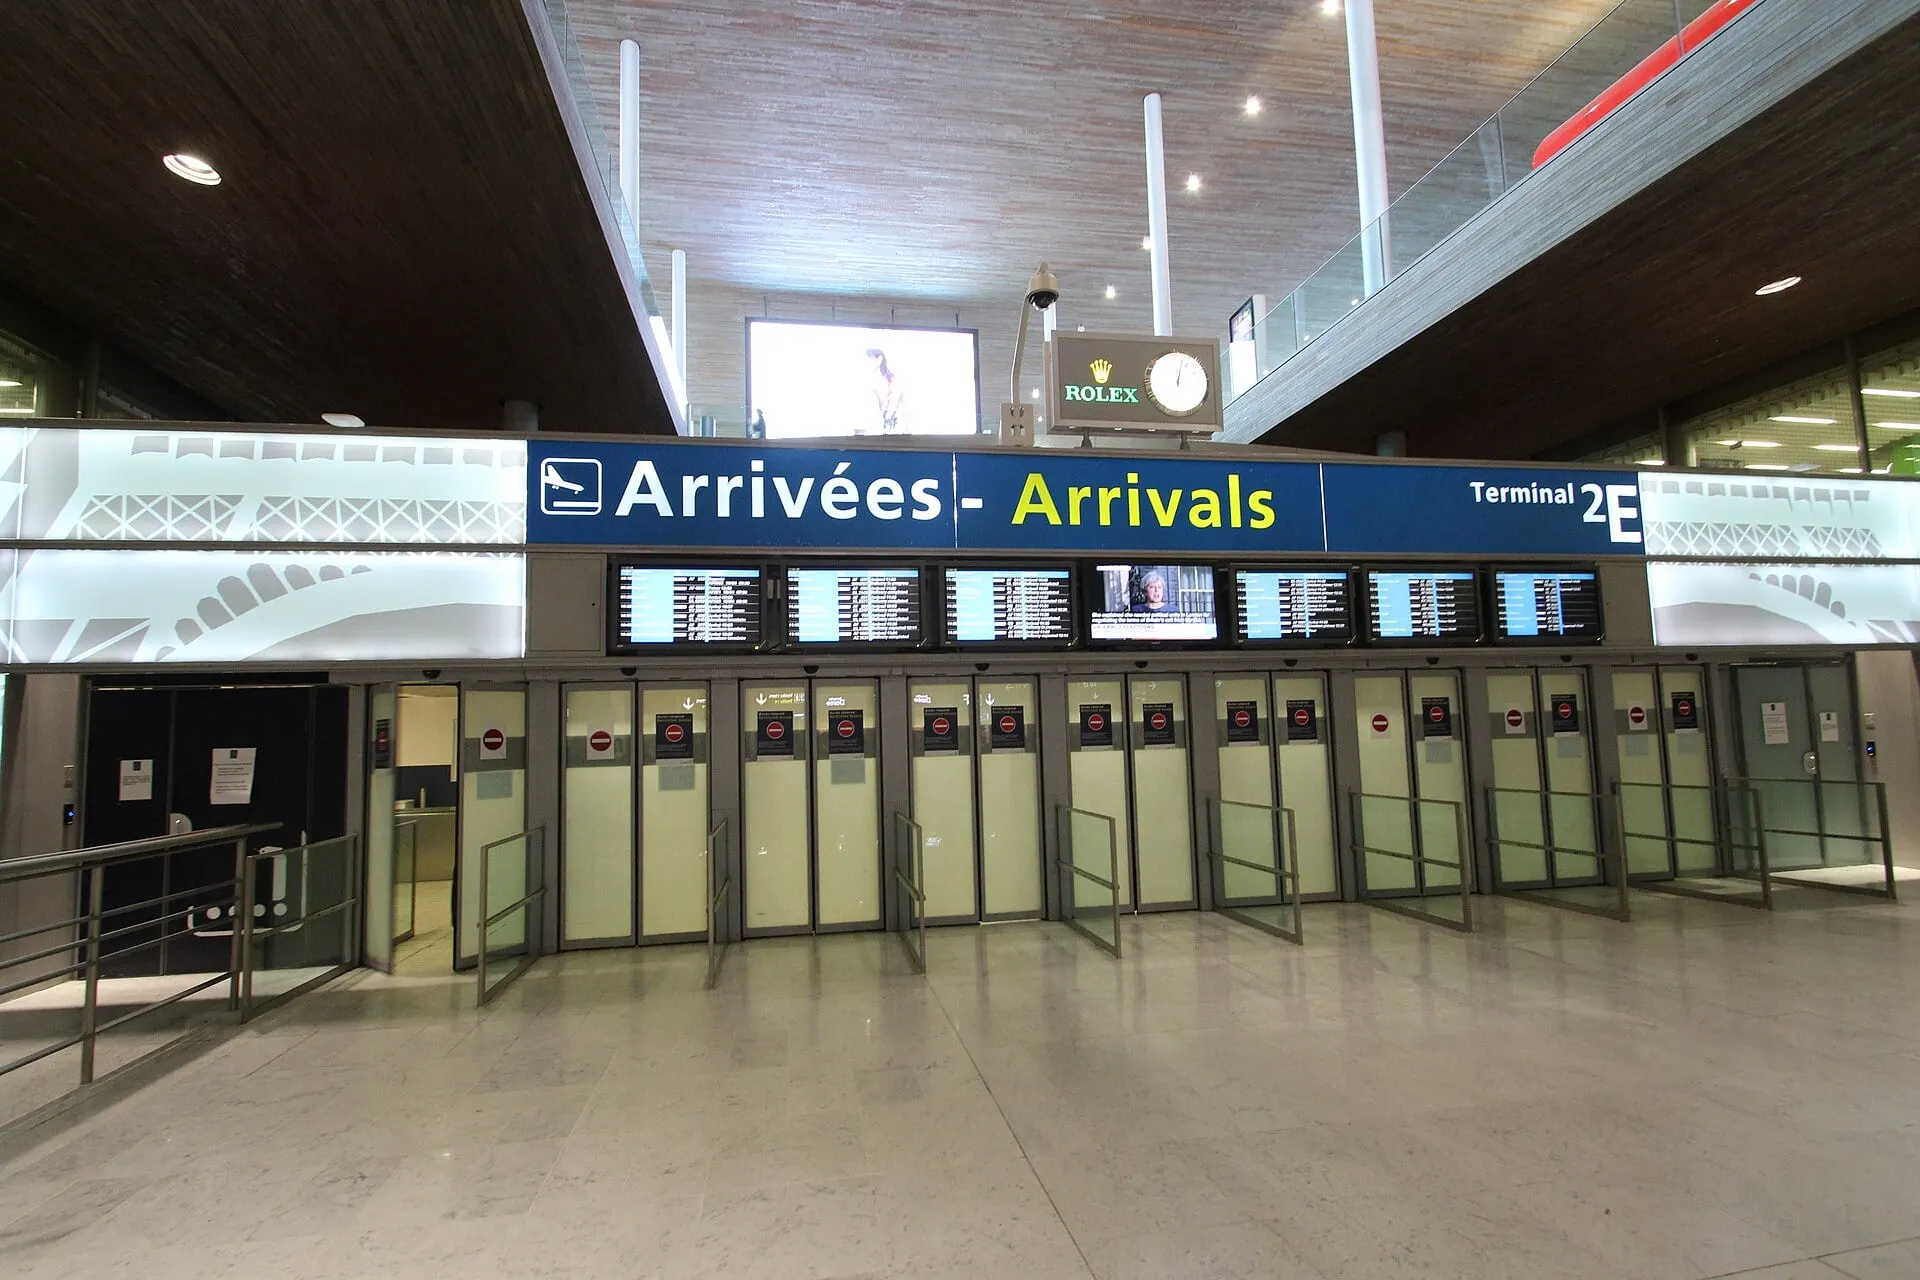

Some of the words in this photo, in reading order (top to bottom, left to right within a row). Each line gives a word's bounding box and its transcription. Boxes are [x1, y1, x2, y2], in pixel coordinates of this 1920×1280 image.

[1064, 385, 1139, 403] ROLEX
[614, 459, 942, 521] Arrivées
[1011, 472, 1276, 530] Arrivals
[1469, 481, 1575, 505] Terminal
[1581, 483, 1642, 543] 2E
